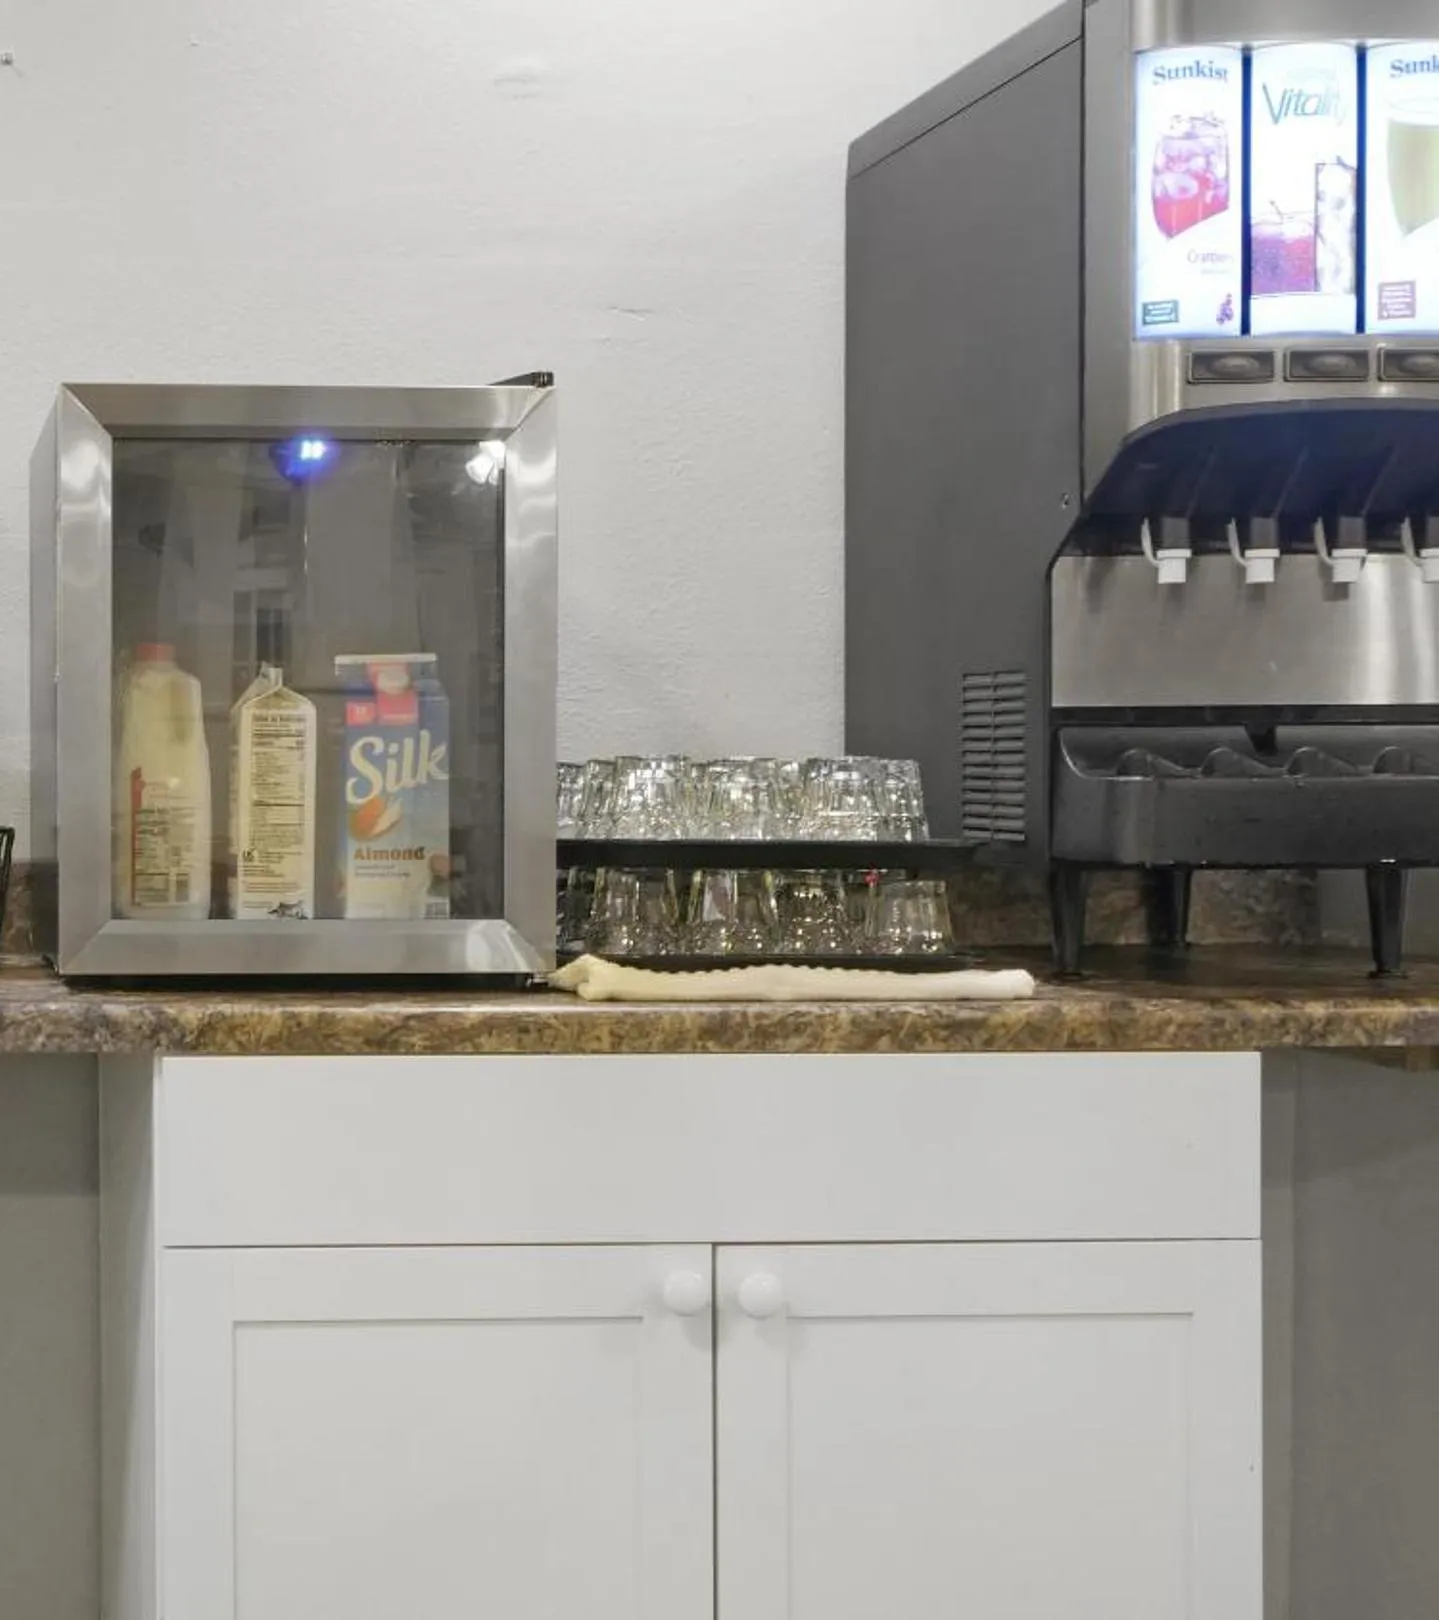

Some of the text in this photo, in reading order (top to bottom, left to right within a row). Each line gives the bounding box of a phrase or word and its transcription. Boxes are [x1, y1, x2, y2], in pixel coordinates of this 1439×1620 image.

[1152, 60, 1228, 85] Sunkist
[346, 730, 449, 805] Silk
[354, 846, 425, 861] Almond
